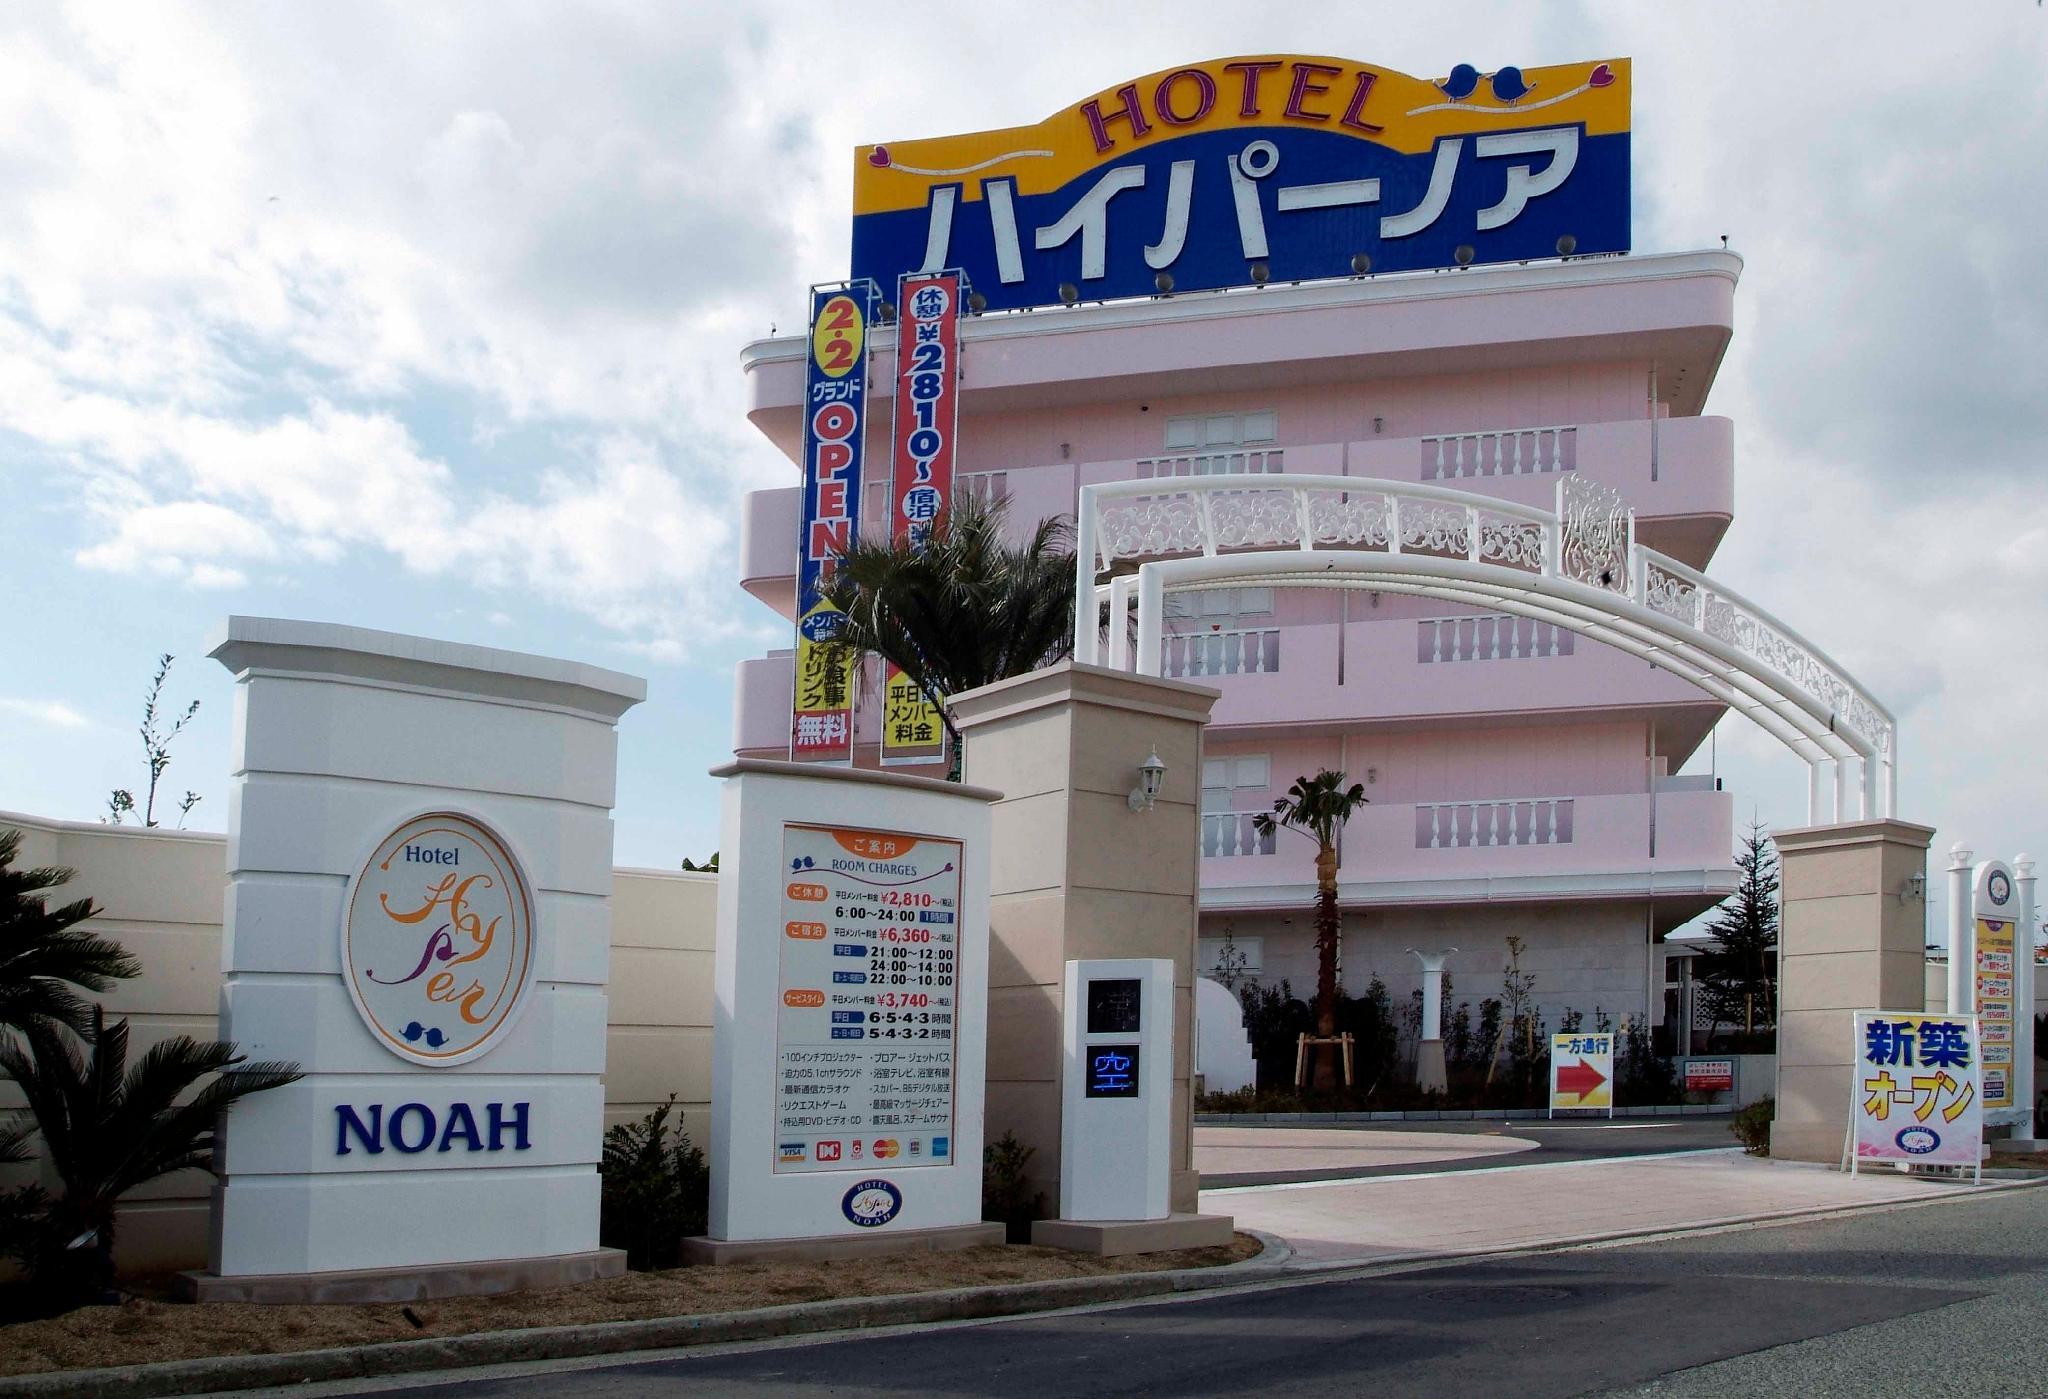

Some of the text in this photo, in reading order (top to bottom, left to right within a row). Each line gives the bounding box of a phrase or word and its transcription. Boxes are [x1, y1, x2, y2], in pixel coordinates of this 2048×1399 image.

[1079, 60, 1384, 154] HOTEL
[908, 126, 1580, 283] ハイパーノア
[916, 288, 943, 318] 休憩
[813, 379, 861, 402] グランド
[908, 488, 936, 519] 宿泊
[803, 646, 824, 708] ドリンク
[891, 686, 919, 703] 平日
[889, 704, 941, 722] メンバー
[797, 714, 847, 745] 無料
[895, 723, 933, 743] 料金
[406, 845, 460, 866] Hotel
[853, 838, 896, 855] ご案内
[832, 859, 917, 877] ROOM CHARGES
[835, 947, 852, 955] 平日
[785, 993, 824, 1004] サービスタイム
[834, 1013, 850, 1022] 平日
[1556, 1037, 1609, 1054] 一方通行
[1866, 1020, 1971, 1068] 新築
[1093, 1052, 1130, 1090] 空
[1864, 1070, 1974, 1124] オープン
[335, 1102, 531, 1156] NOAH
[857, 1182, 887, 1192] HOTEL
[853, 1213, 891, 1225] NOAH
